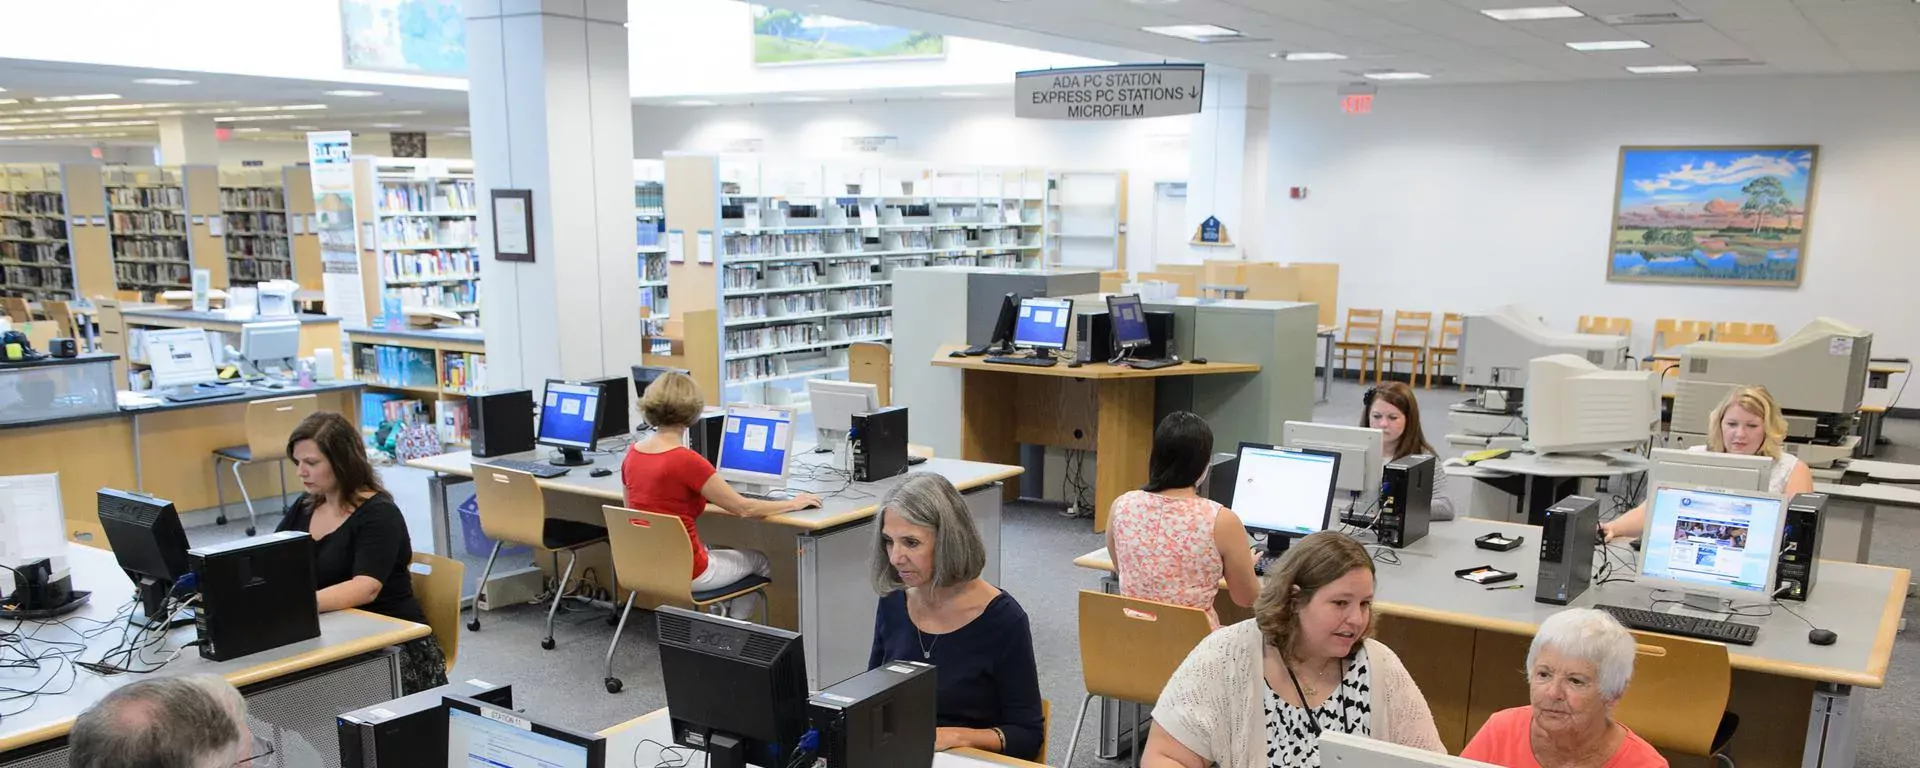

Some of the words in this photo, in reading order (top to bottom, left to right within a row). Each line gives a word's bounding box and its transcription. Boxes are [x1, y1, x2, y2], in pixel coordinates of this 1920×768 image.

[1053, 75, 1080, 89] ADA
[1084, 74, 1102, 87] PC
[1106, 72, 1162, 87] STATION
[1032, 90, 1092, 104] EXPRESS
[1096, 89, 1114, 102] PC
[1118, 86, 1184, 101] STATIONS
[1068, 104, 1144, 118] MICROFILM
[1346, 95, 1373, 113] EXIT
